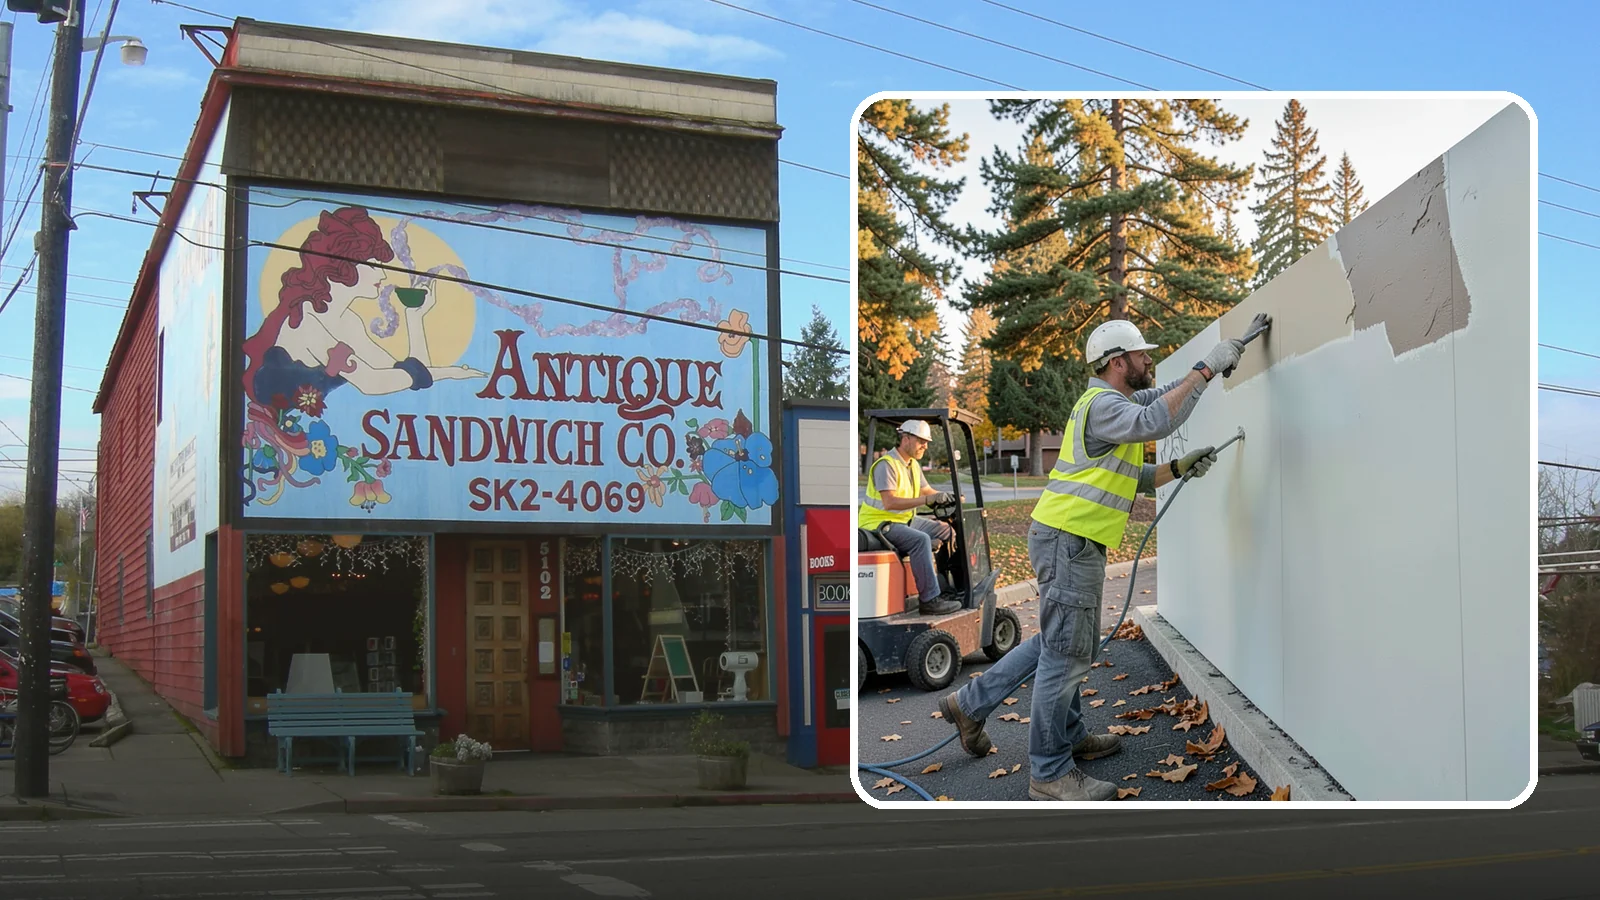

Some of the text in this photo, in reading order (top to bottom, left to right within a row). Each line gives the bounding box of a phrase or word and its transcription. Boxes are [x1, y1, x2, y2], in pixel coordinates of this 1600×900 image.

[476, 329, 723, 421] ANTIQUE
[361, 409, 685, 468] SANDWICH CO.
[469, 477, 645, 513] SK2-4069
[540, 542, 551, 599] 5102
[809, 555, 835, 569] BOOKS
